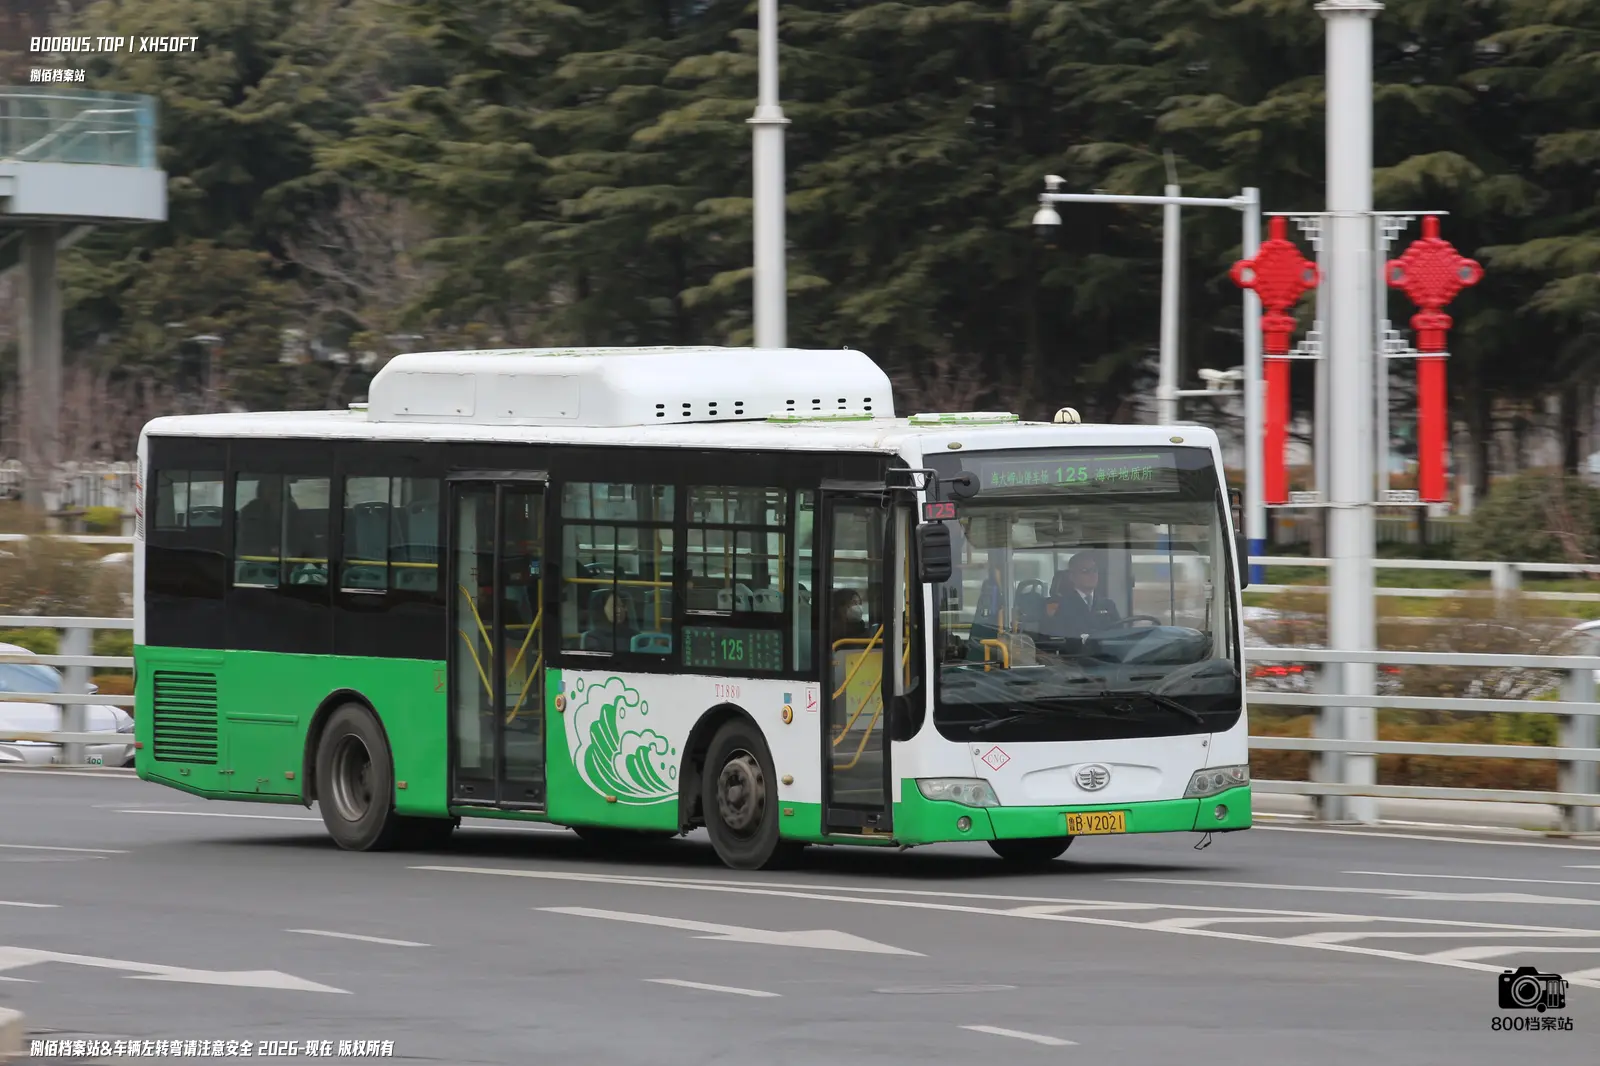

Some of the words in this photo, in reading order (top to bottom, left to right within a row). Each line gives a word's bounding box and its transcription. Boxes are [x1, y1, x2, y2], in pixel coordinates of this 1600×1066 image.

[1055, 466, 1089, 483] 125
[1095, 465, 1153, 482] 海洋地质所
[926, 503, 955, 518] 125
[720, 638, 744, 661] 125
[715, 683, 741, 699] T1880
[988, 754, 1005, 764] CNG
